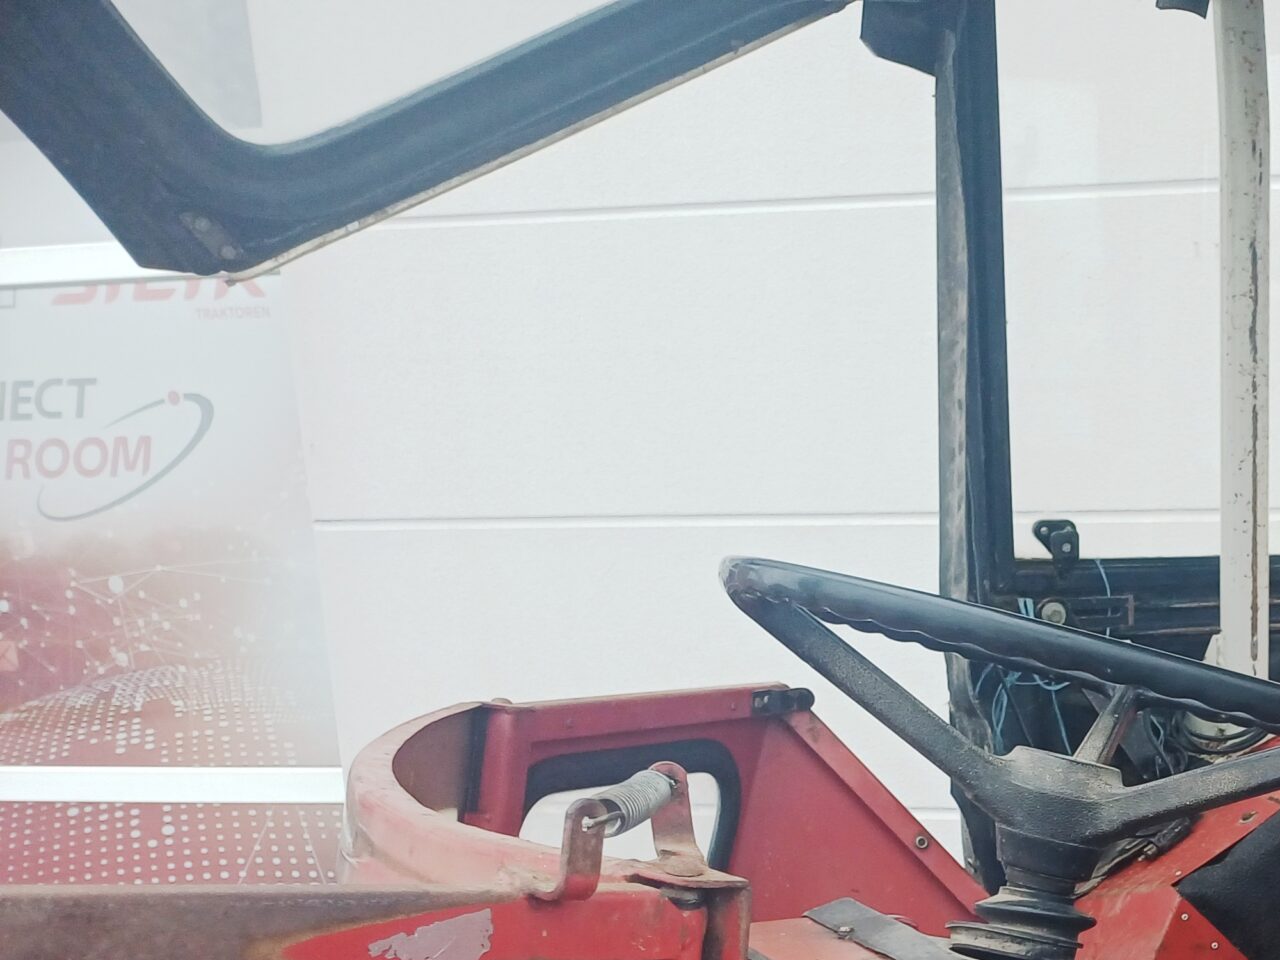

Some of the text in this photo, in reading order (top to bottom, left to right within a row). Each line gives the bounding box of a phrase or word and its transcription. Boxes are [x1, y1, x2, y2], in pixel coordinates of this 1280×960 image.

[195, 306, 271, 319] TRAKTOREN
[0, 377, 97, 422] ECT
[5, 435, 153, 480] ROOM
